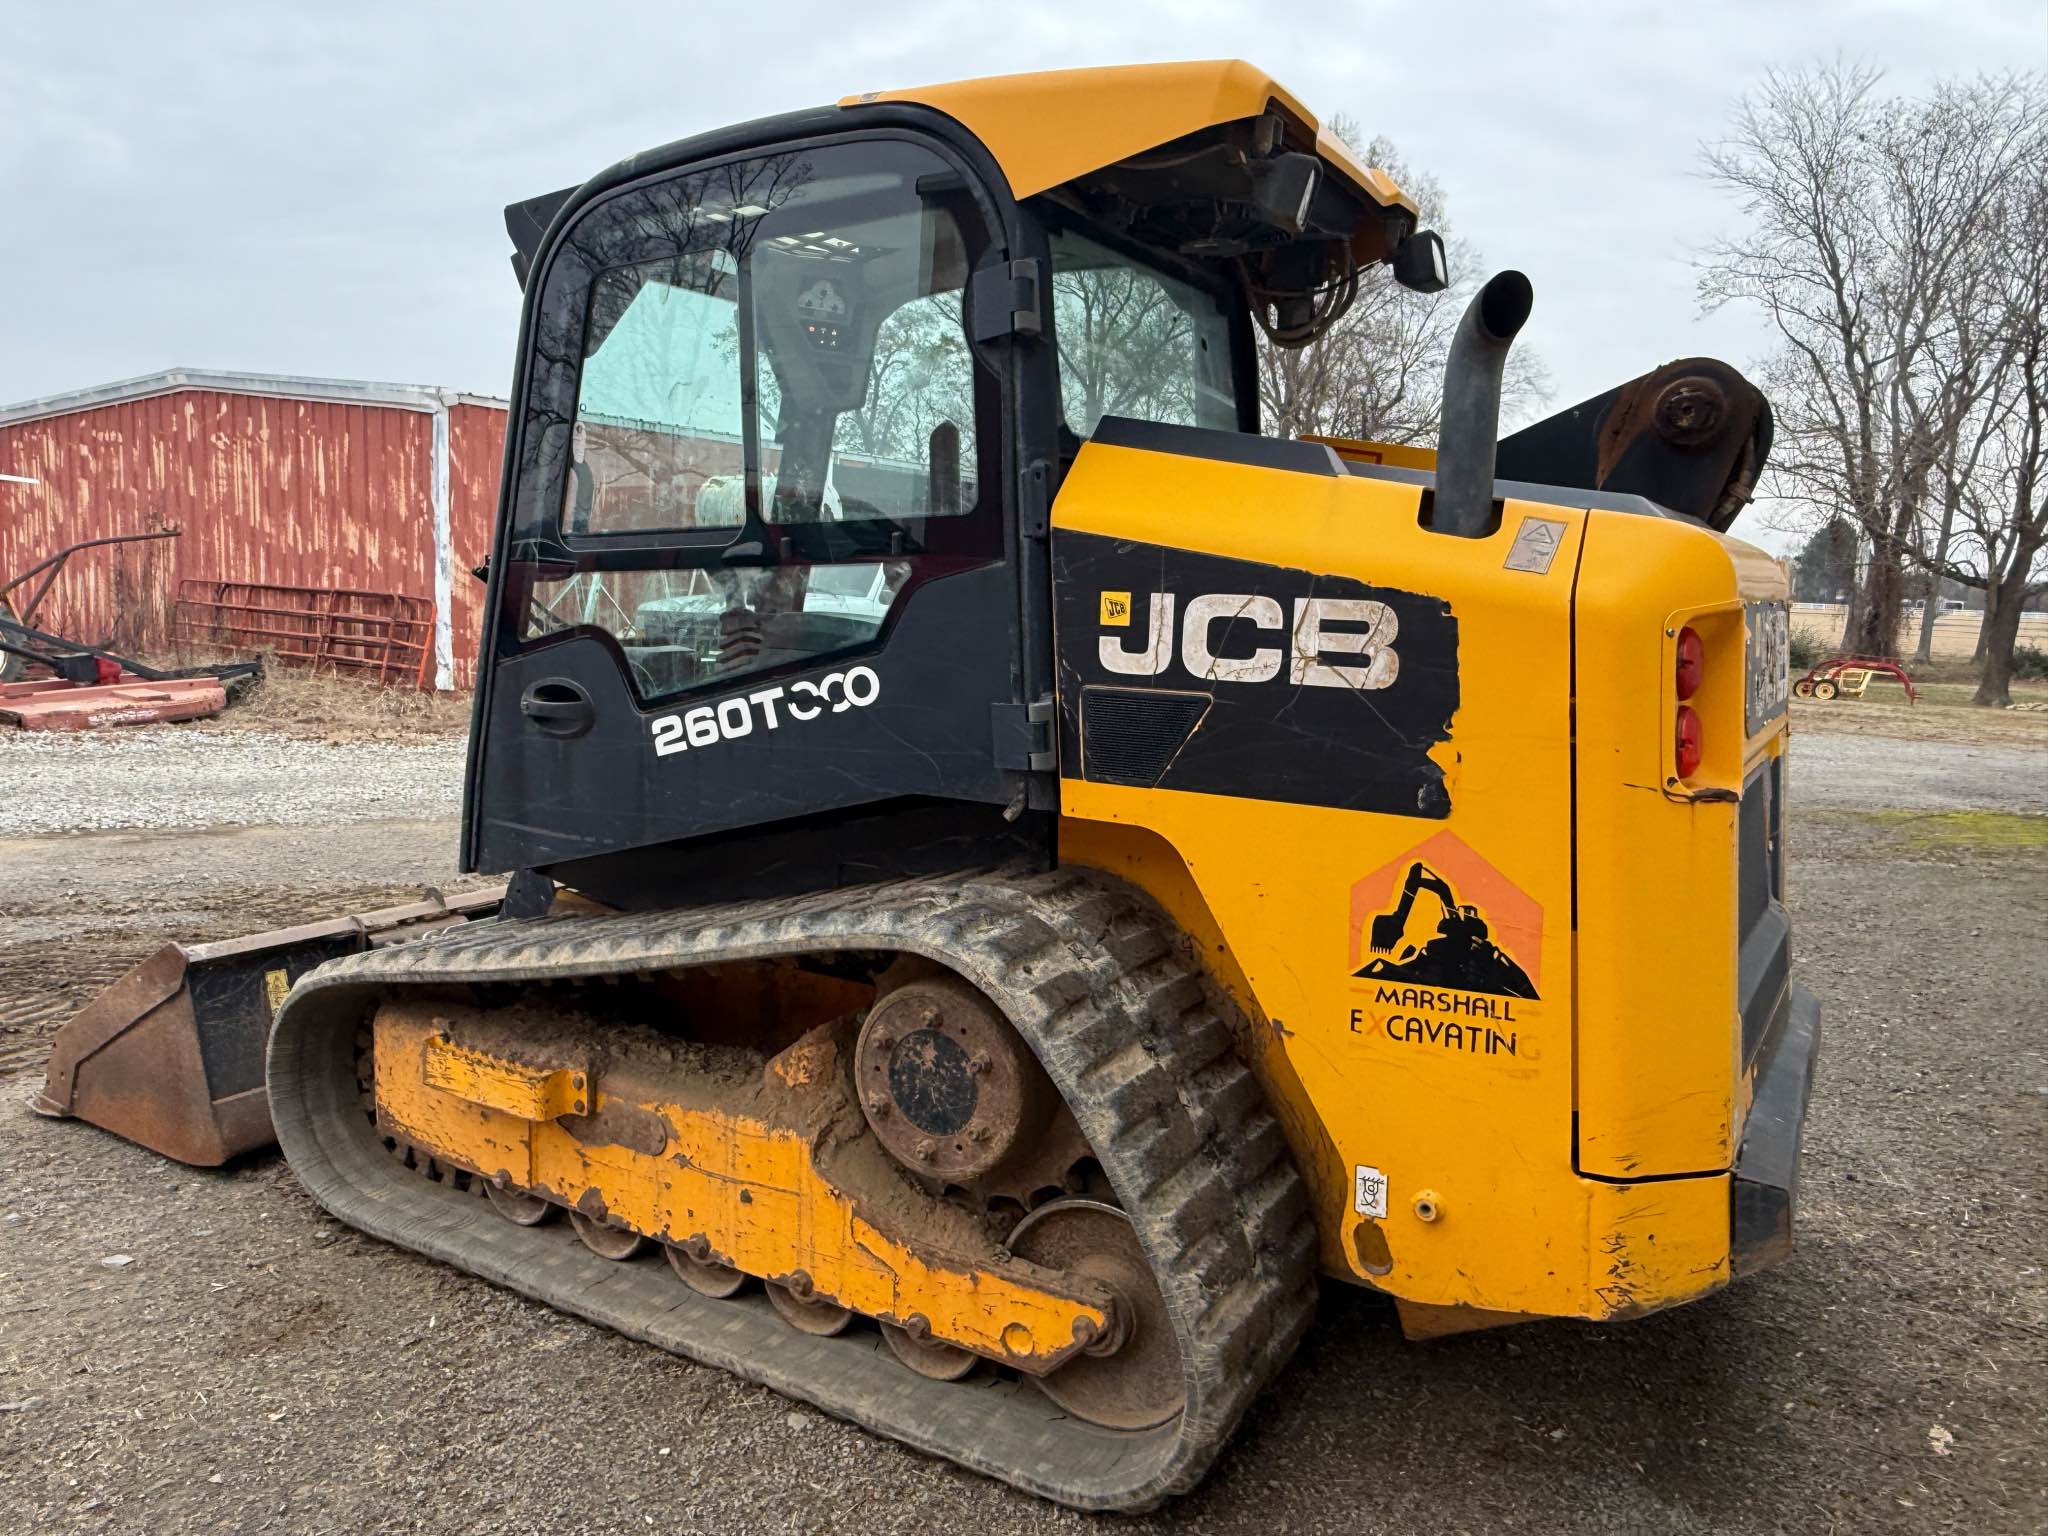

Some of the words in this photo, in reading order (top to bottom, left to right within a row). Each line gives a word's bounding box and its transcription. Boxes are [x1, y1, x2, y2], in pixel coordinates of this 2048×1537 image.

[1109, 600, 1126, 617] JCB
[1099, 593, 1399, 689] JCB
[1375, 986, 1516, 1022] MARSHALL
